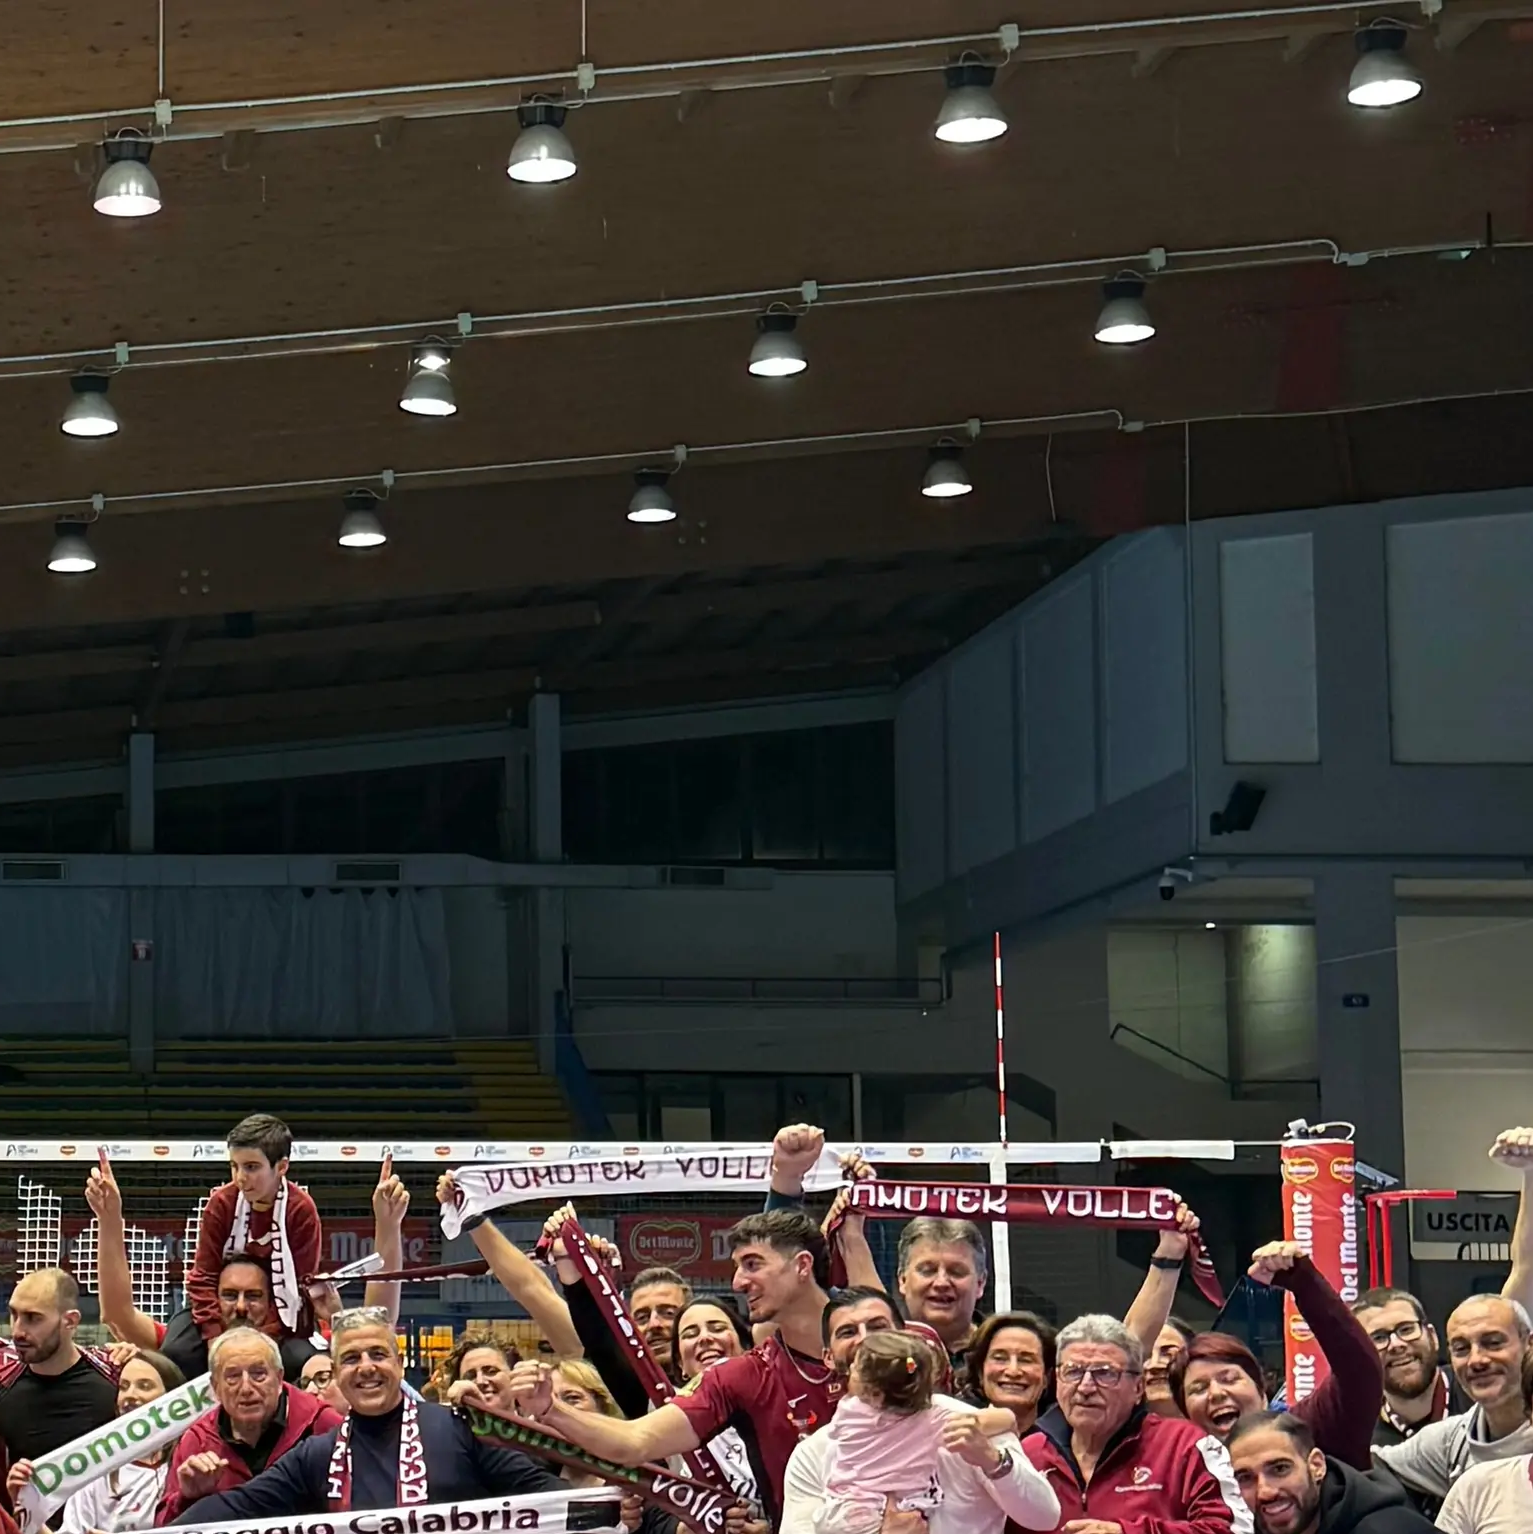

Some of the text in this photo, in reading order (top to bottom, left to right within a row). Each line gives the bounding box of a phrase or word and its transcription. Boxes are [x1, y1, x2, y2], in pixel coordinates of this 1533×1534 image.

[675, 1156, 773, 1179] VOLL
[1339, 1192, 1358, 1264] Monte
[1426, 1212, 1511, 1232] USCITA
[31, 1384, 217, 1497] Domotek
